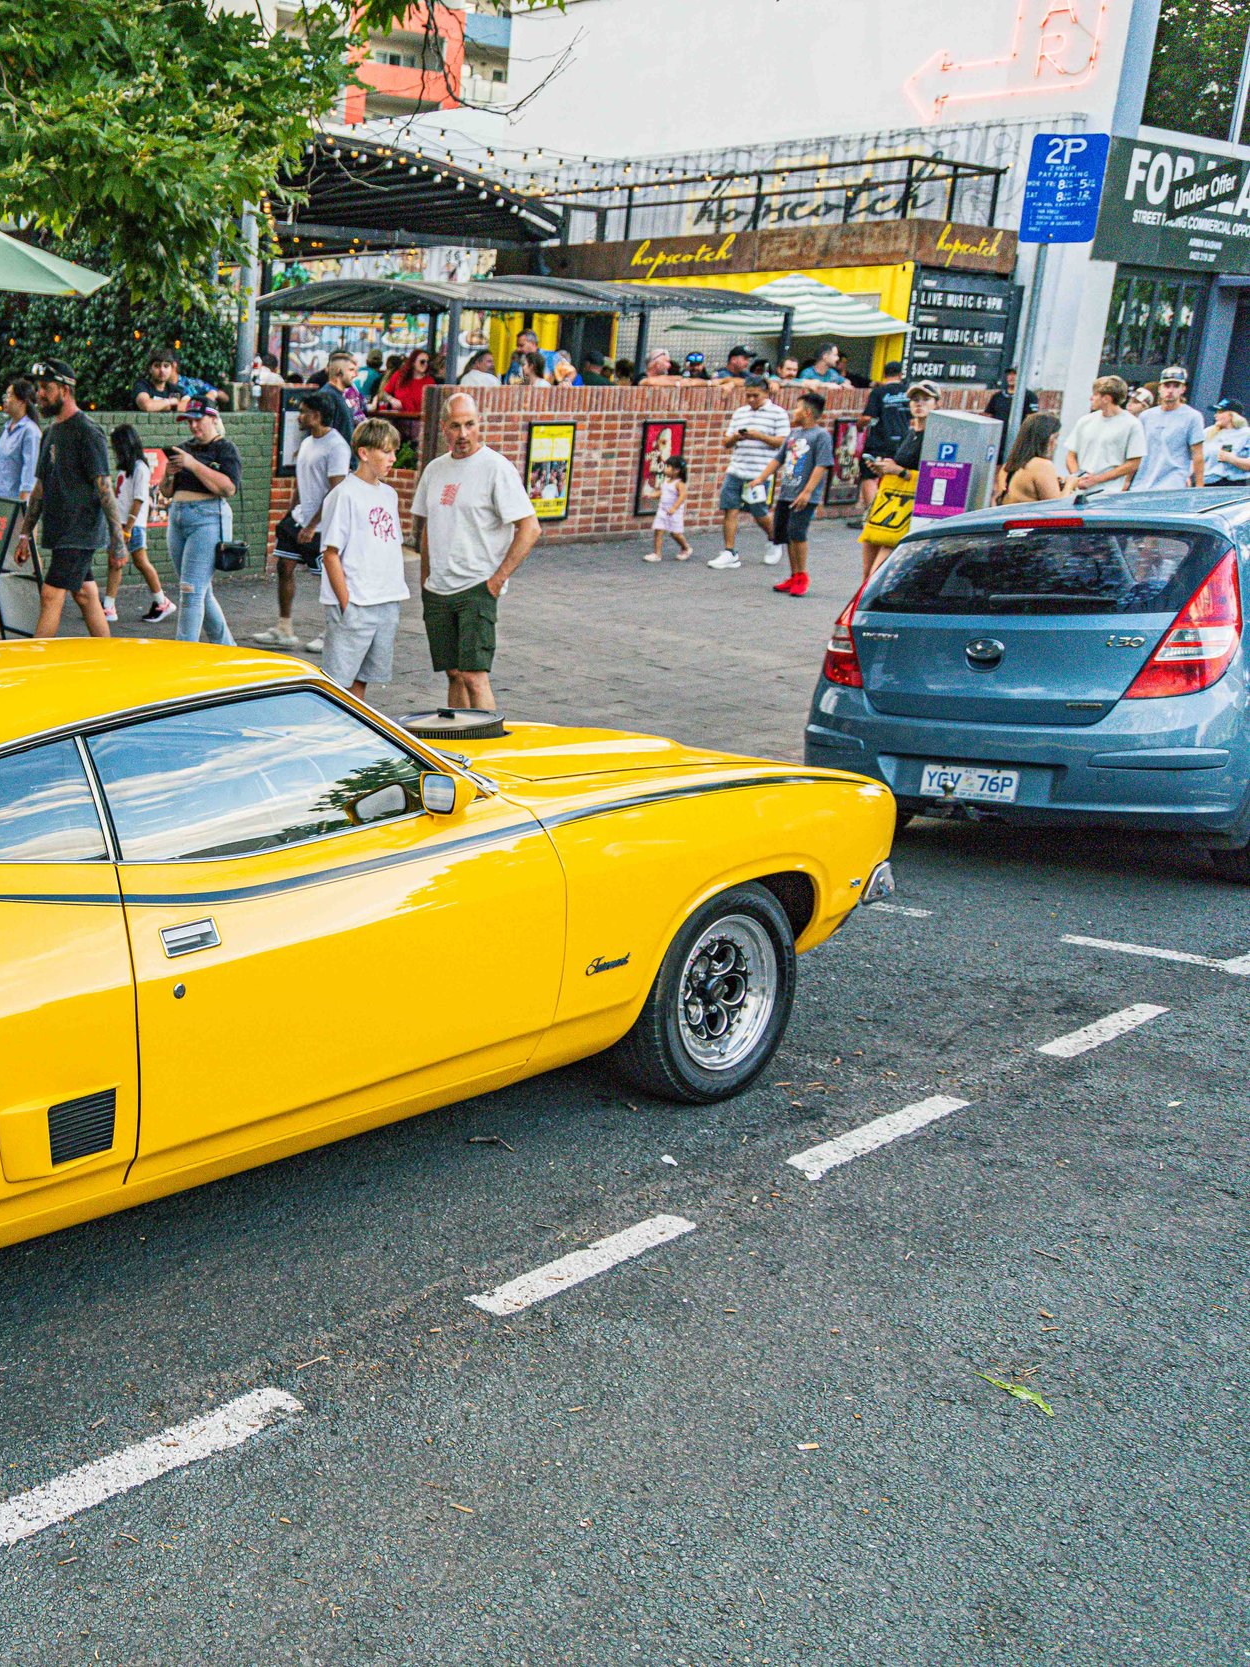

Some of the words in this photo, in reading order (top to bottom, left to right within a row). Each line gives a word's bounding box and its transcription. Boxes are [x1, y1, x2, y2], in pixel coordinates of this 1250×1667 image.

[1045, 137, 1088, 164] 2P
[1173, 182, 1210, 210] Under
[1210, 173, 1237, 198] Offer
[1132, 208, 1163, 226] STREET
[1187, 215, 1232, 235] COMMERCIAL
[630, 233, 736, 280] hopscotch
[935, 223, 1004, 268] hopscotch
[920, 291, 944, 306] LIVE
[946, 293, 974, 308] MUSIC
[915, 327, 939, 342] LIVE
[942, 328, 970, 343] MUSIC
[949, 364, 977, 378] WINGS
[940, 444, 954, 459] P
[977, 774, 1013, 793] 76P
